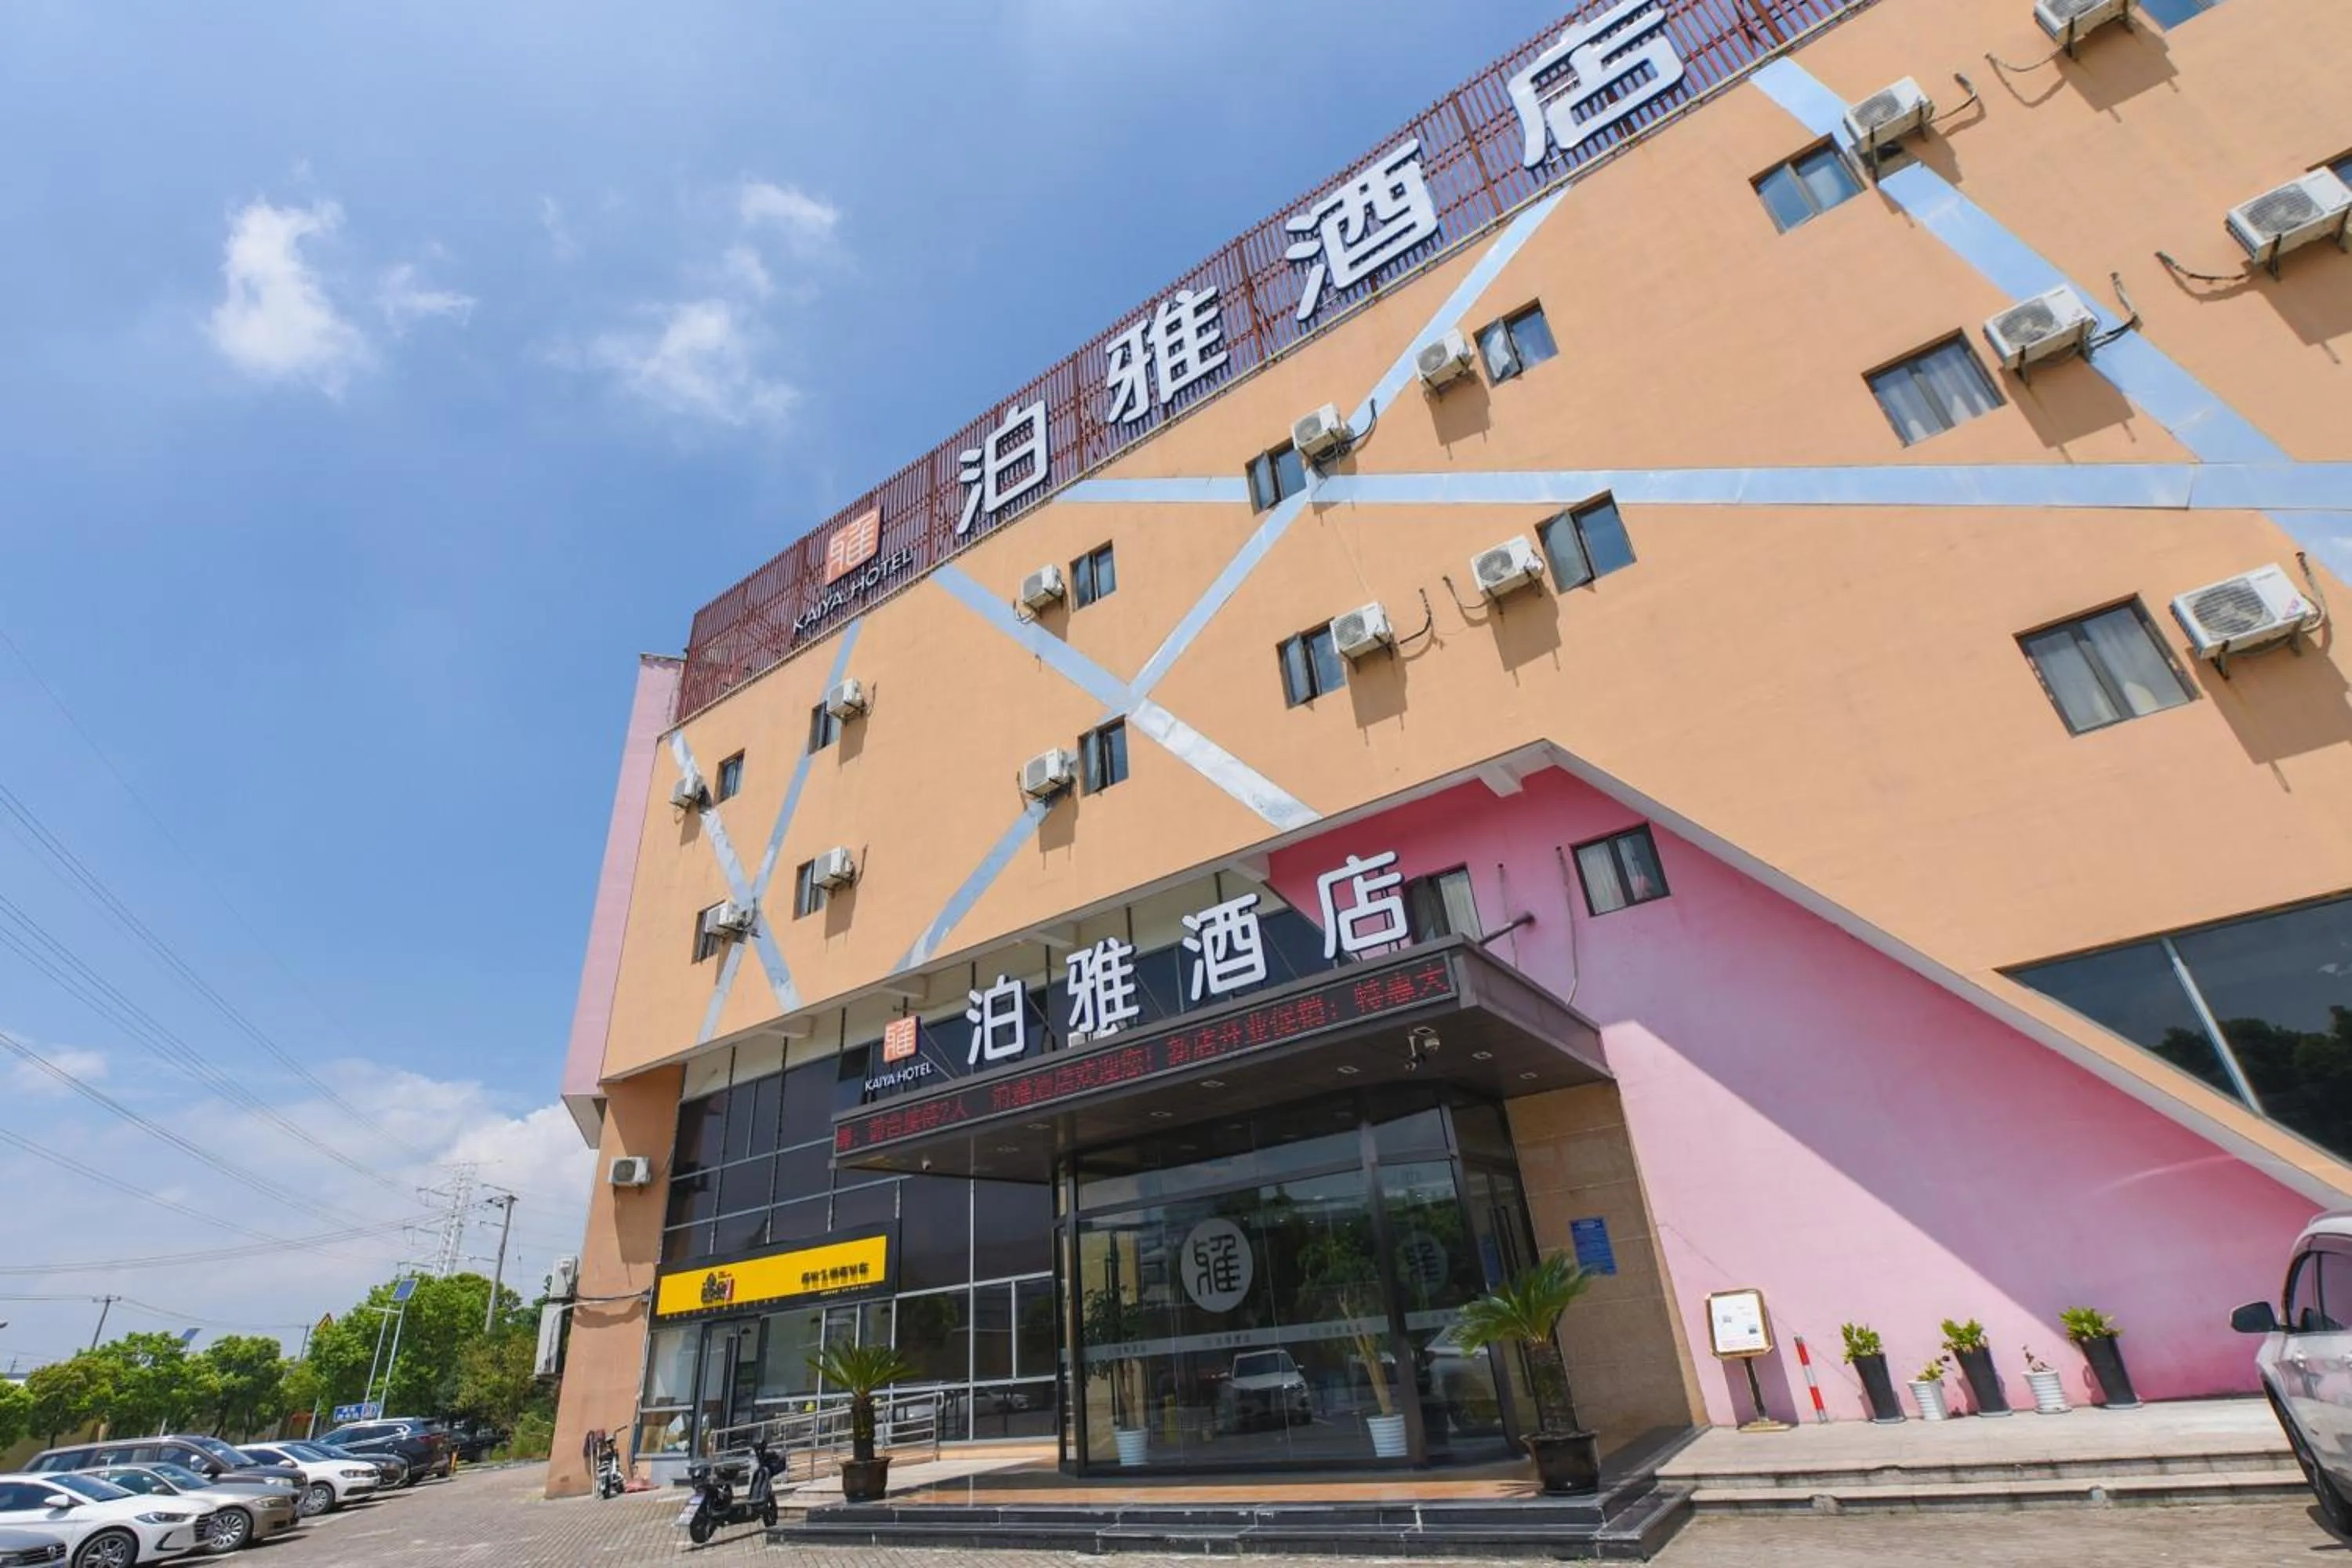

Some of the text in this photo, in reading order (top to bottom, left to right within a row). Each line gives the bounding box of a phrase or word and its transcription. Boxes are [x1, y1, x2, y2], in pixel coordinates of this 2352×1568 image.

[956, 0, 1685, 535] 泊雅酒店
[792, 546, 915, 634] KAIYA HOTEL
[965, 850, 1408, 1065] 泊雅酒店
[865, 1062, 933, 1092] KAIYA HOTEL
